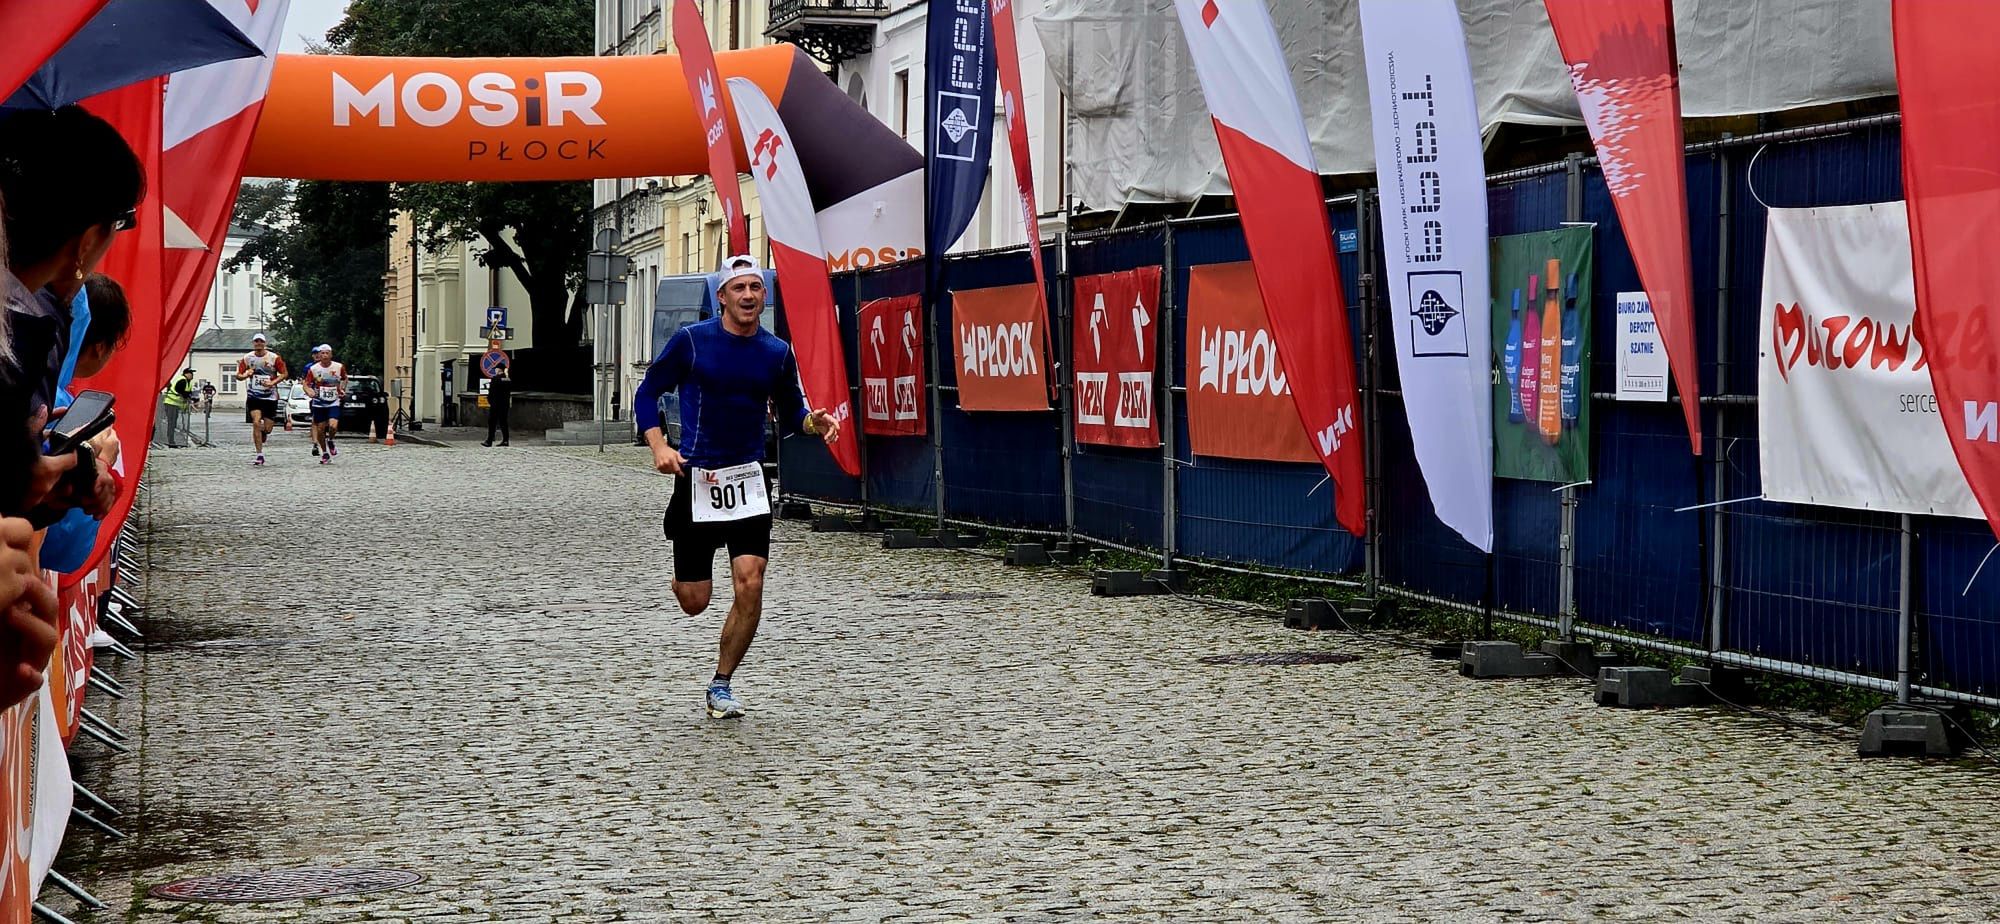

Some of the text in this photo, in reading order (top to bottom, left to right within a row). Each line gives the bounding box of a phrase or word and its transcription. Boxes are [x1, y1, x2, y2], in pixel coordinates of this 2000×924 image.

[332, 70, 608, 128] MOSiR
[468, 138, 607, 161] PŁOCK
[827, 247, 922, 274] MOS
[1618, 302, 1636, 314] BIURO
[1629, 322, 1655, 334] DEPOZYT
[977, 322, 1038, 378] PŁOCK
[1631, 343, 1654, 354] SZATNIE
[1222, 328, 1291, 396] PŁOC
[1899, 394, 1937, 413] serce
[709, 480, 748, 510] 901
